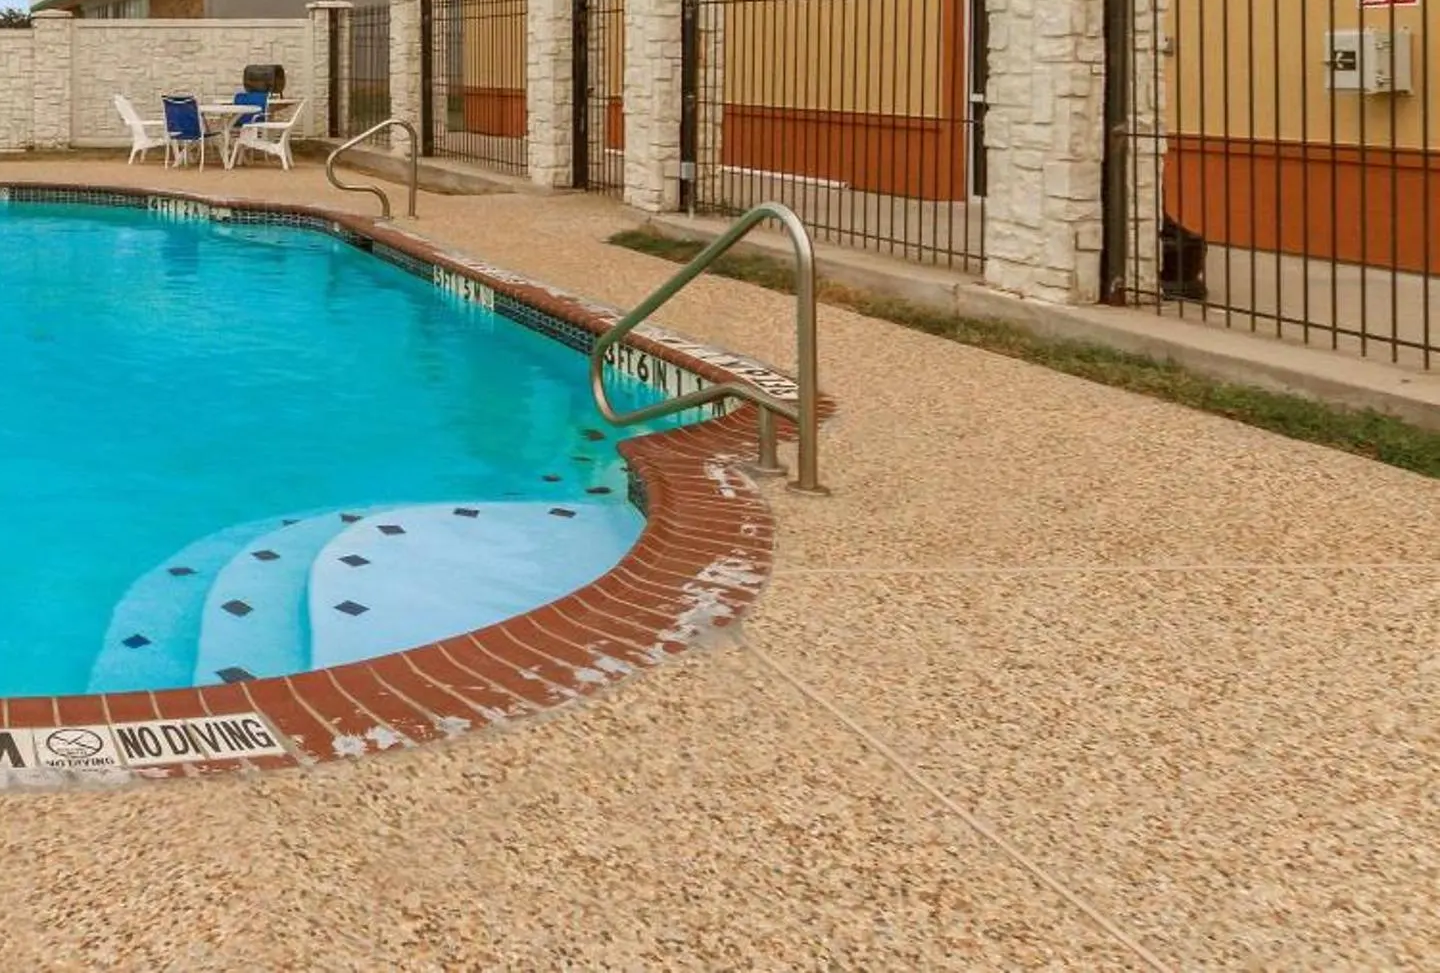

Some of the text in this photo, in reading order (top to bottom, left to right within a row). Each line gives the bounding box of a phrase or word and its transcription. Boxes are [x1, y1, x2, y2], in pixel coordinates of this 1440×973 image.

[637, 354, 649, 382] 6
[116, 717, 277, 761] NO DIVING
